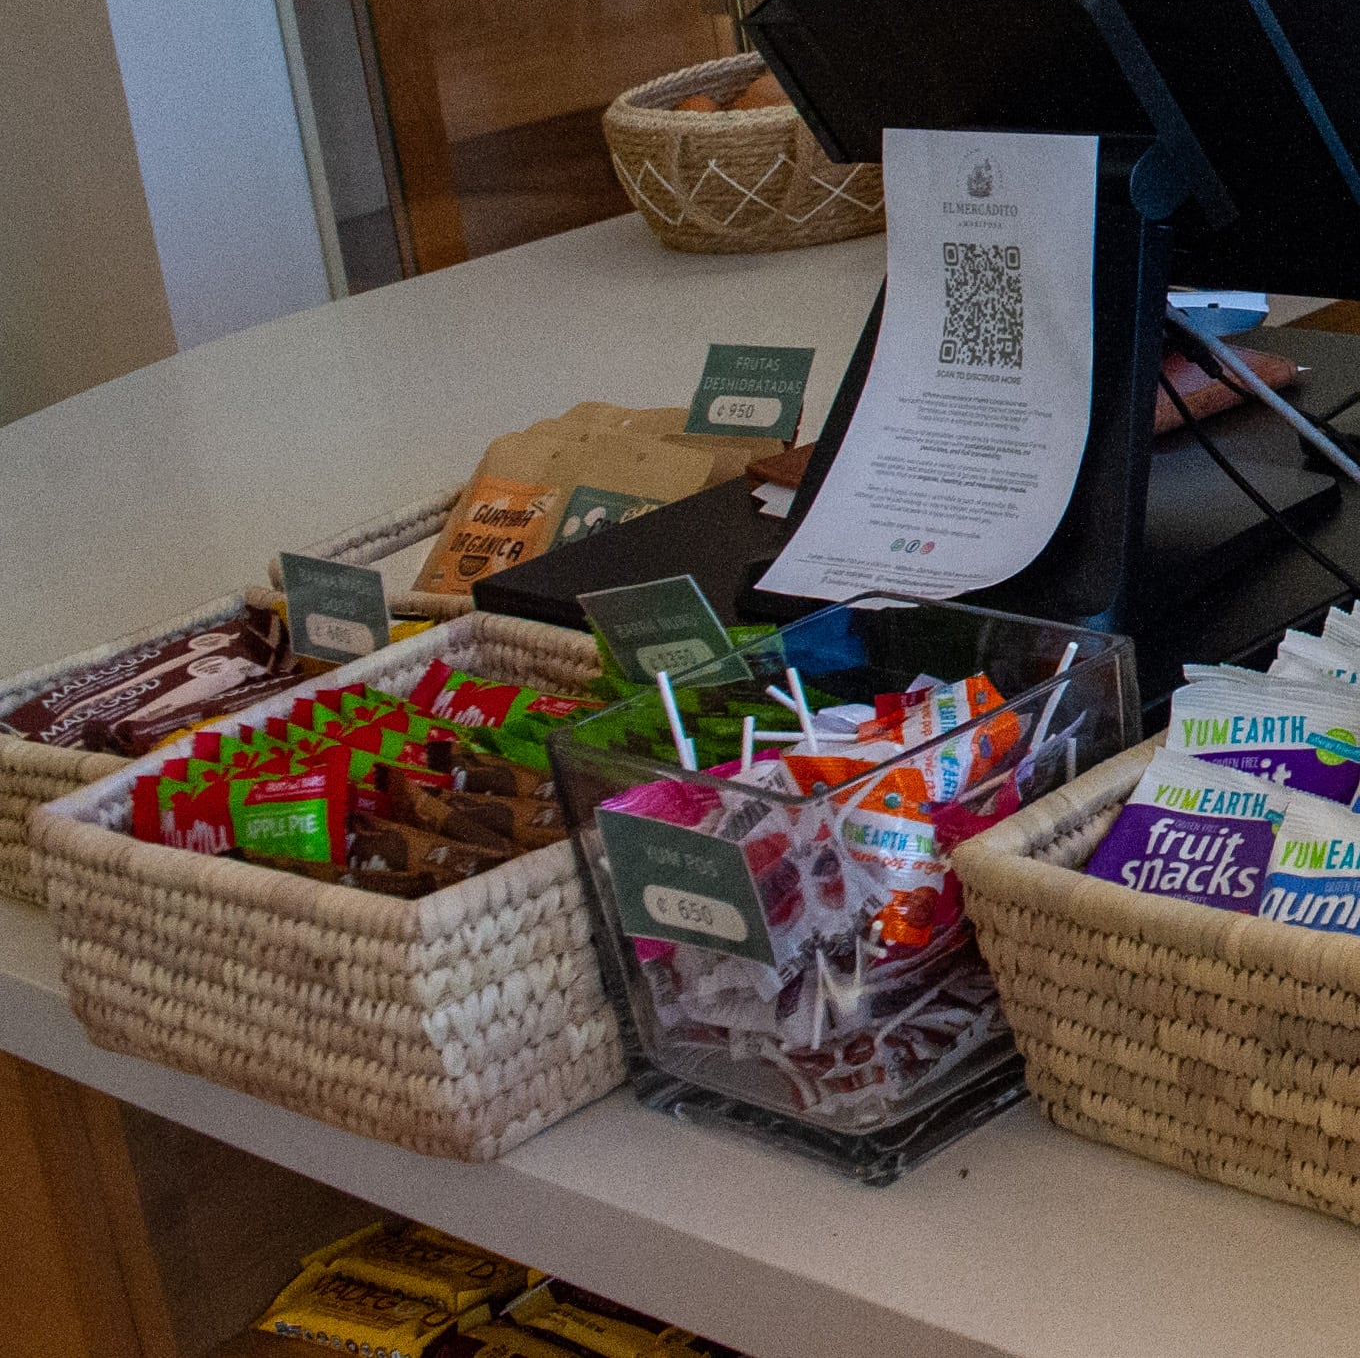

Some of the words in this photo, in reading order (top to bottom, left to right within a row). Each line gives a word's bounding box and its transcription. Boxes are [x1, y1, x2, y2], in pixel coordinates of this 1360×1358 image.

[955, 202, 1019, 217] MERCADITO
[735, 356, 781, 372] FRUTAS
[936, 369, 955, 379] SCAN
[702, 376, 803, 395] DESHIDRATADAS
[729, 402, 756, 420] 950
[1180, 714, 1307, 748] YUMEARTH
[1152, 784, 1268, 819] YUMEARTH
[288, 812, 320, 835] PIE
[1145, 817, 1246, 864] fruit
[1121, 855, 1261, 899] snacks
